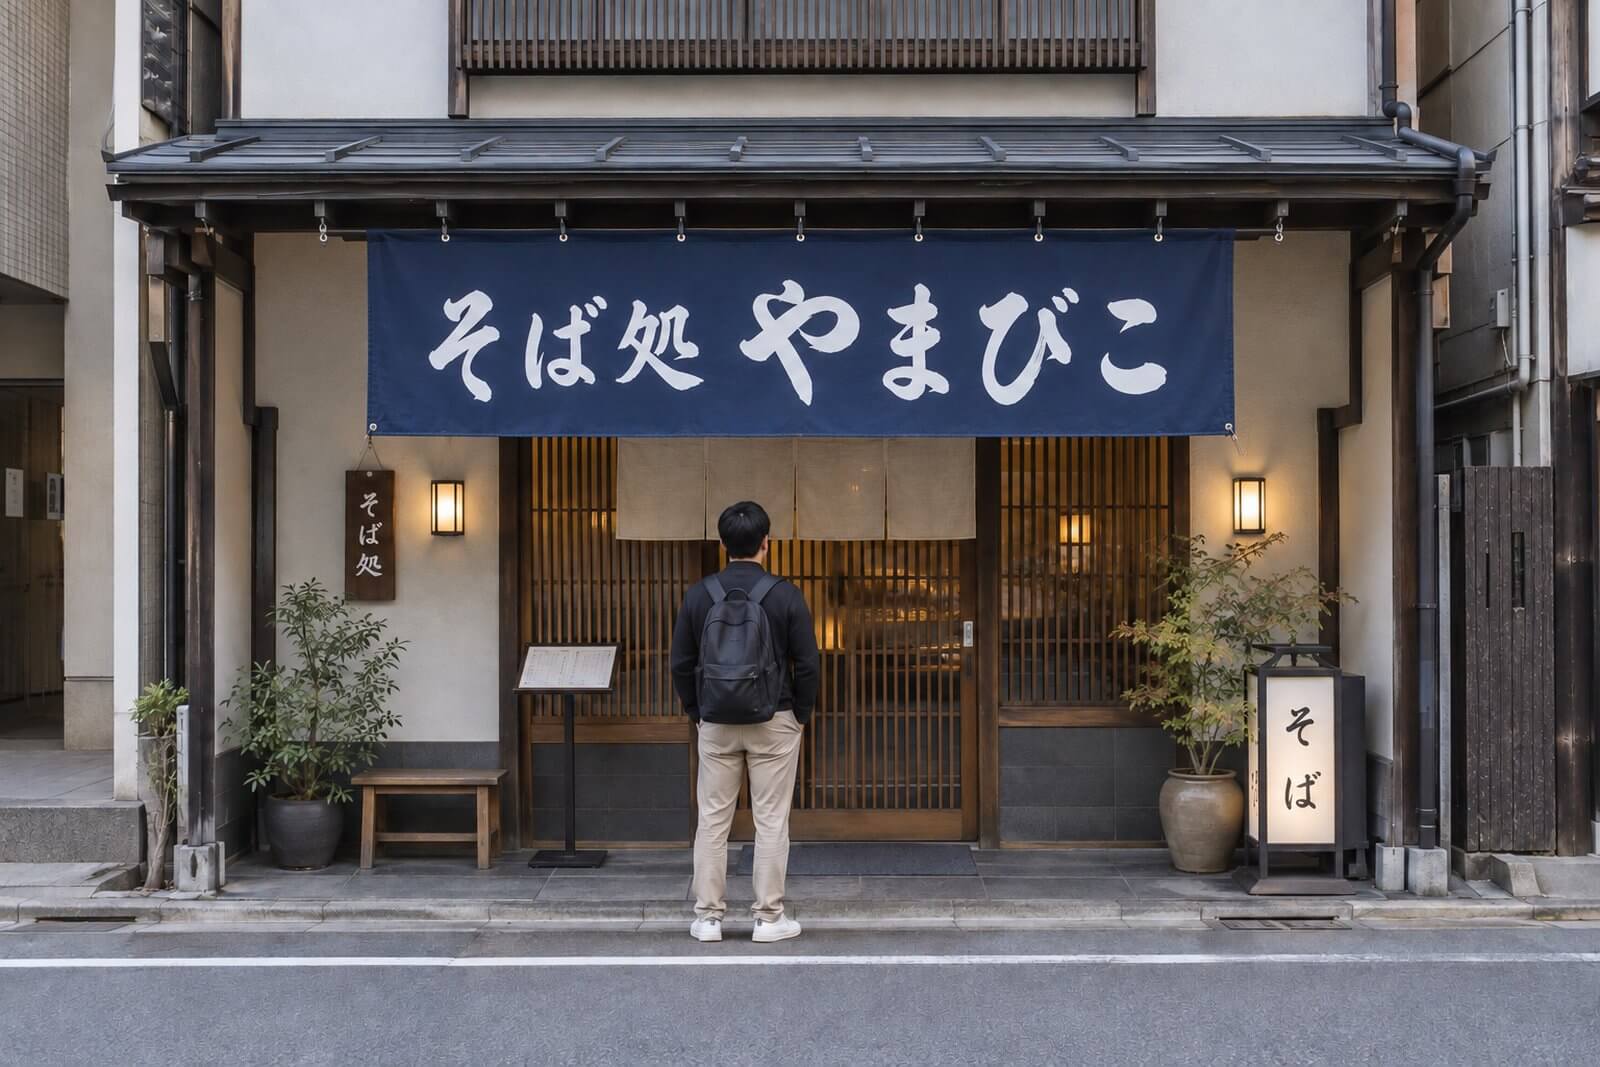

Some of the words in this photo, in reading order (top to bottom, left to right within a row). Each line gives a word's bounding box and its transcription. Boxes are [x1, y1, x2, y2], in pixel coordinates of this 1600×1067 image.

[428, 289, 705, 403] そば処
[739, 279, 1168, 407] やまびこ
[355, 492, 383, 577] そば処
[1285, 706, 1321, 810] そば
